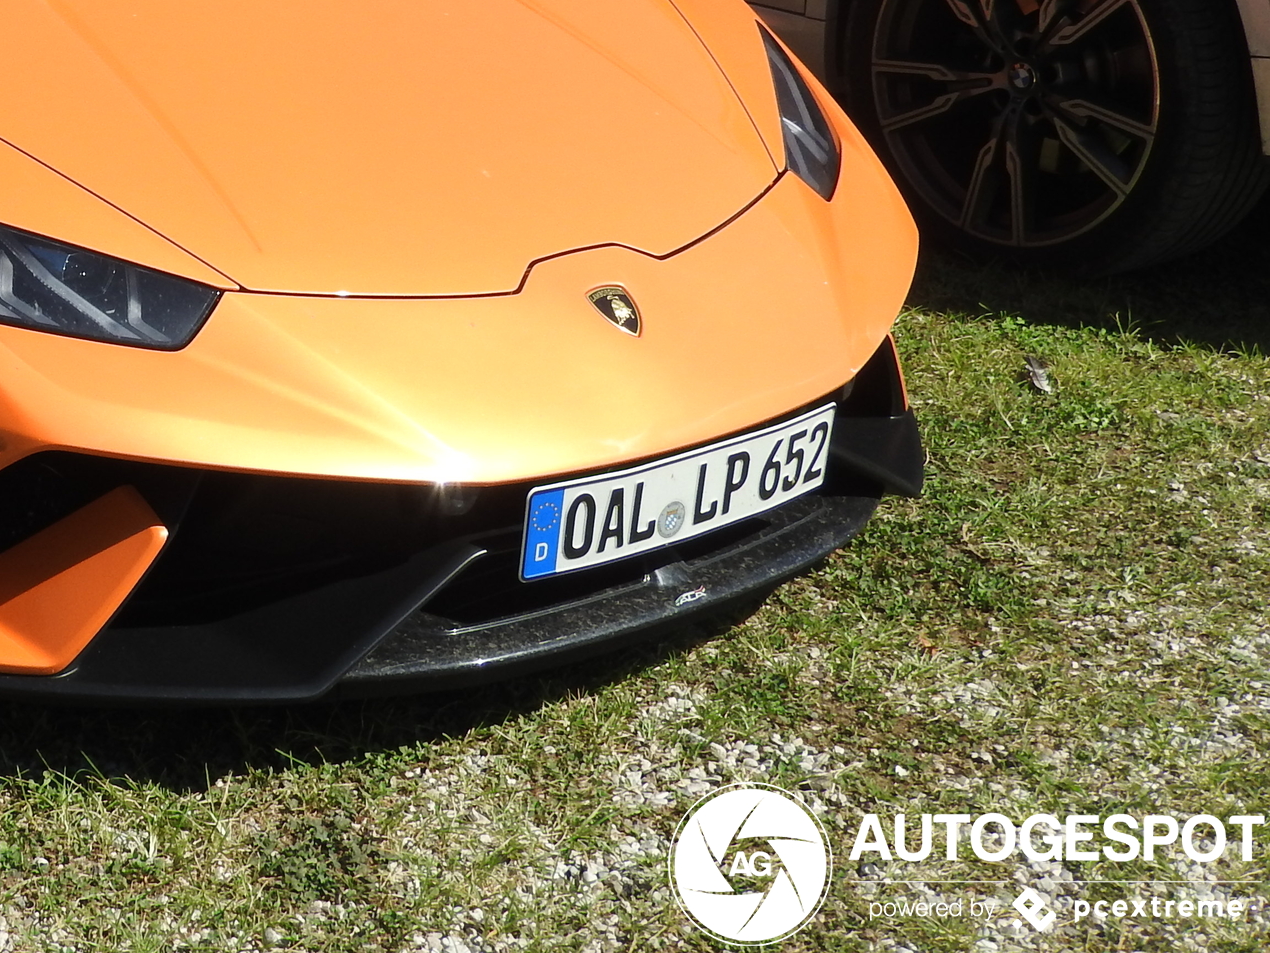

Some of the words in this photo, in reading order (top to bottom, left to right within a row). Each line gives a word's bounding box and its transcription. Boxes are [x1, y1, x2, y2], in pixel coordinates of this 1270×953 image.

[562, 481, 656, 560] OAL
[693, 450, 751, 526] LP
[758, 420, 829, 501] 652
[534, 542, 549, 562] D
